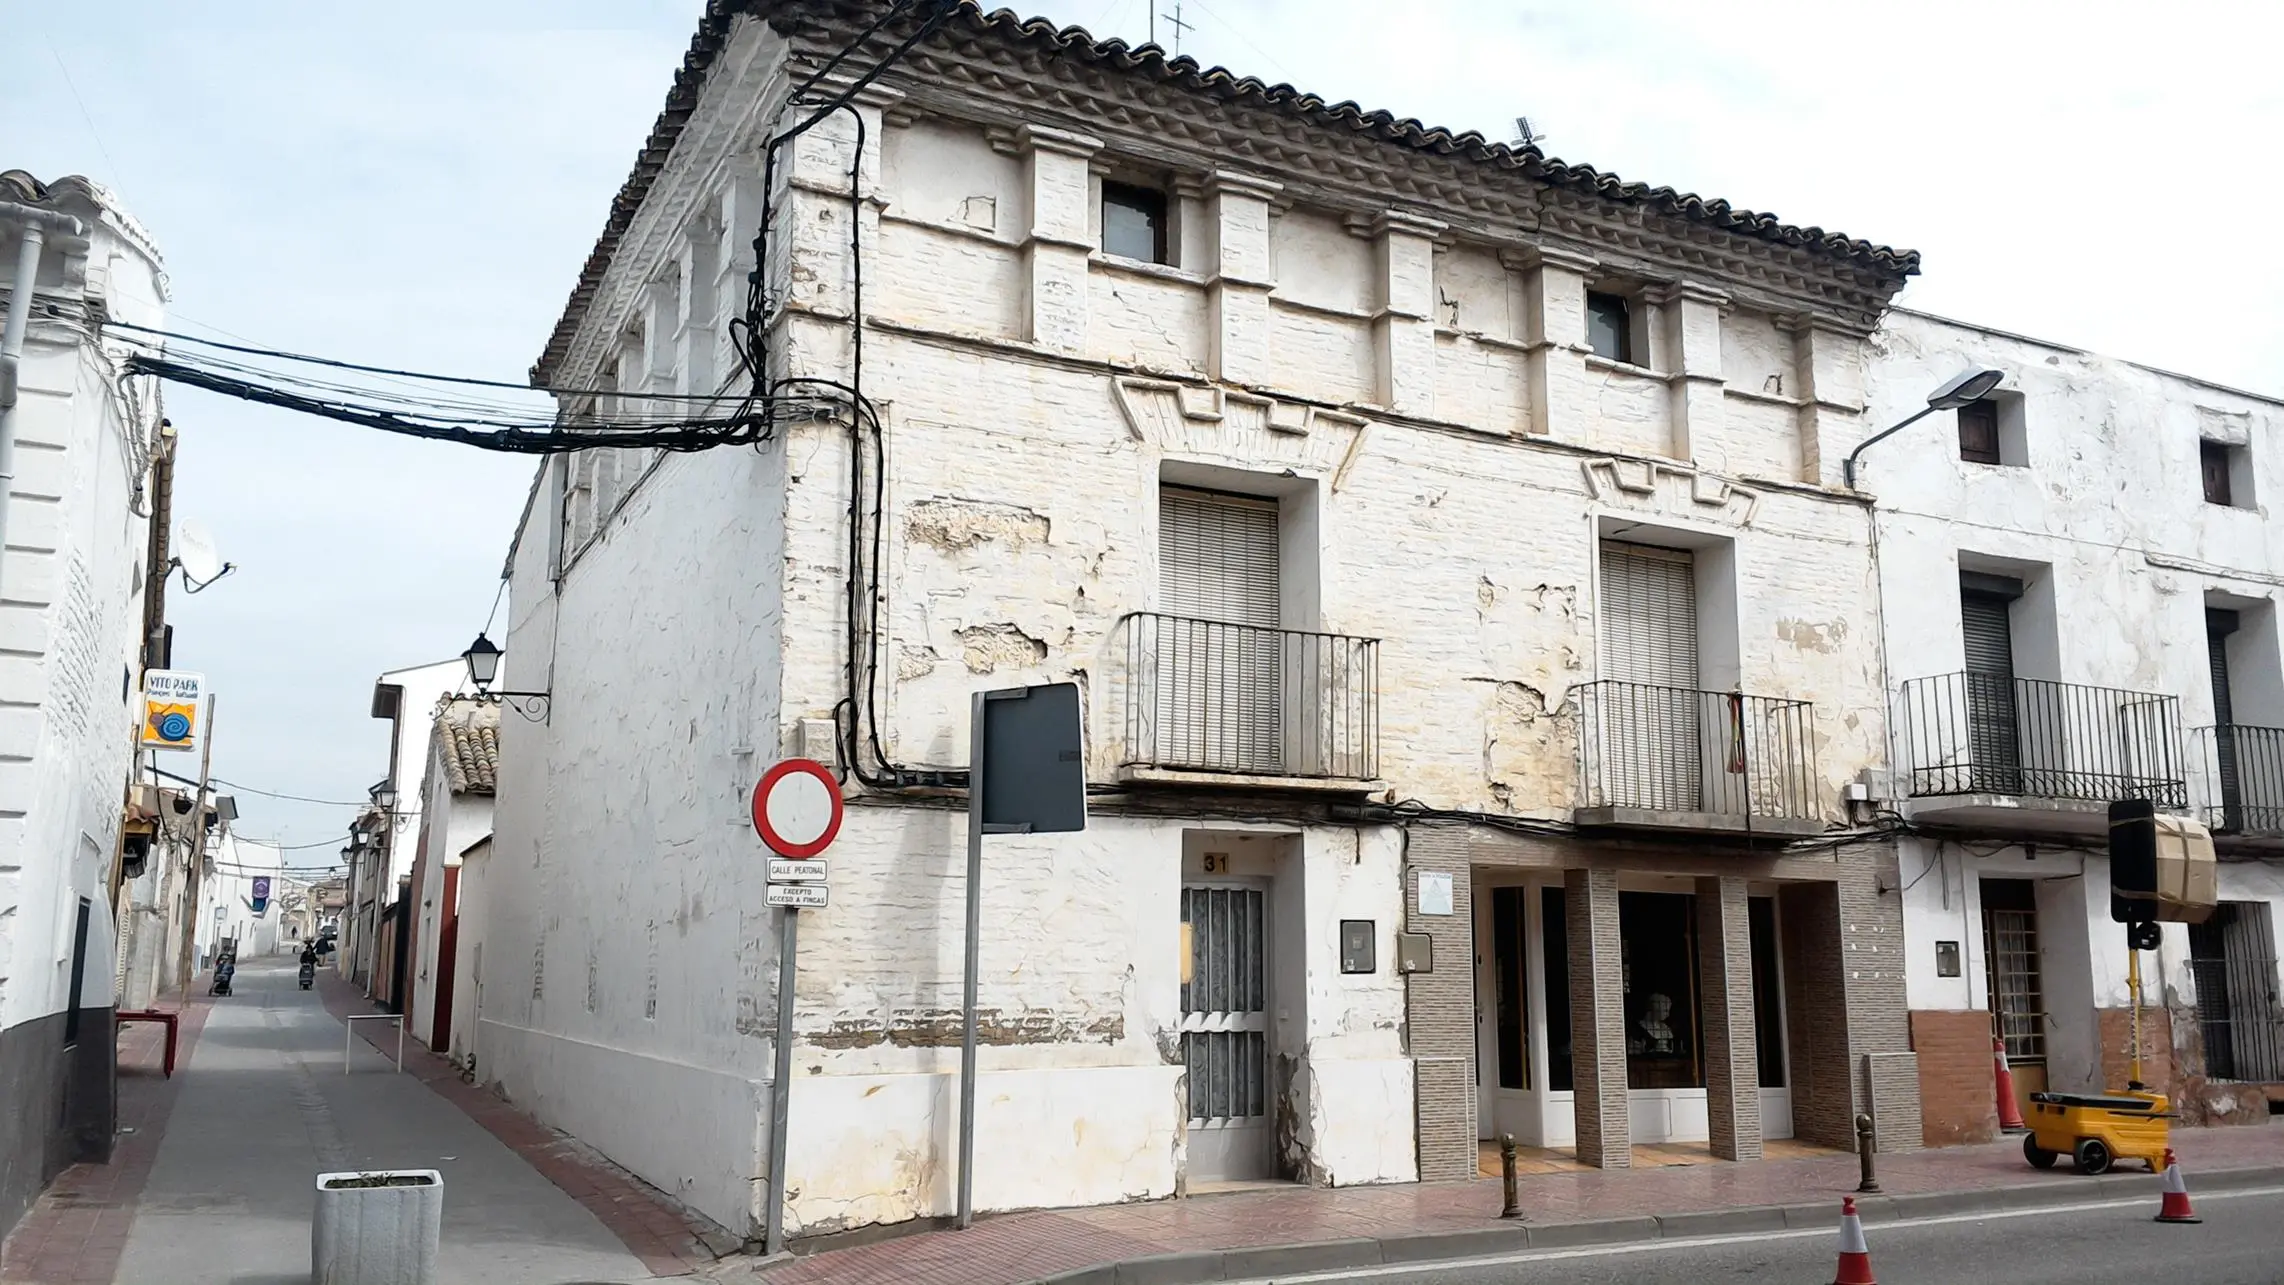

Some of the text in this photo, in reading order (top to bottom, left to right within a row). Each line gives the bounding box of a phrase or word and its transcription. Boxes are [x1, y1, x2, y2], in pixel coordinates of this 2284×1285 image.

[150, 676, 198, 691] VITO PARK
[1204, 855, 1226, 873] 31
[771, 866, 825, 875] CALLE PEATONAL
[769, 895, 794, 903] ACCESO
